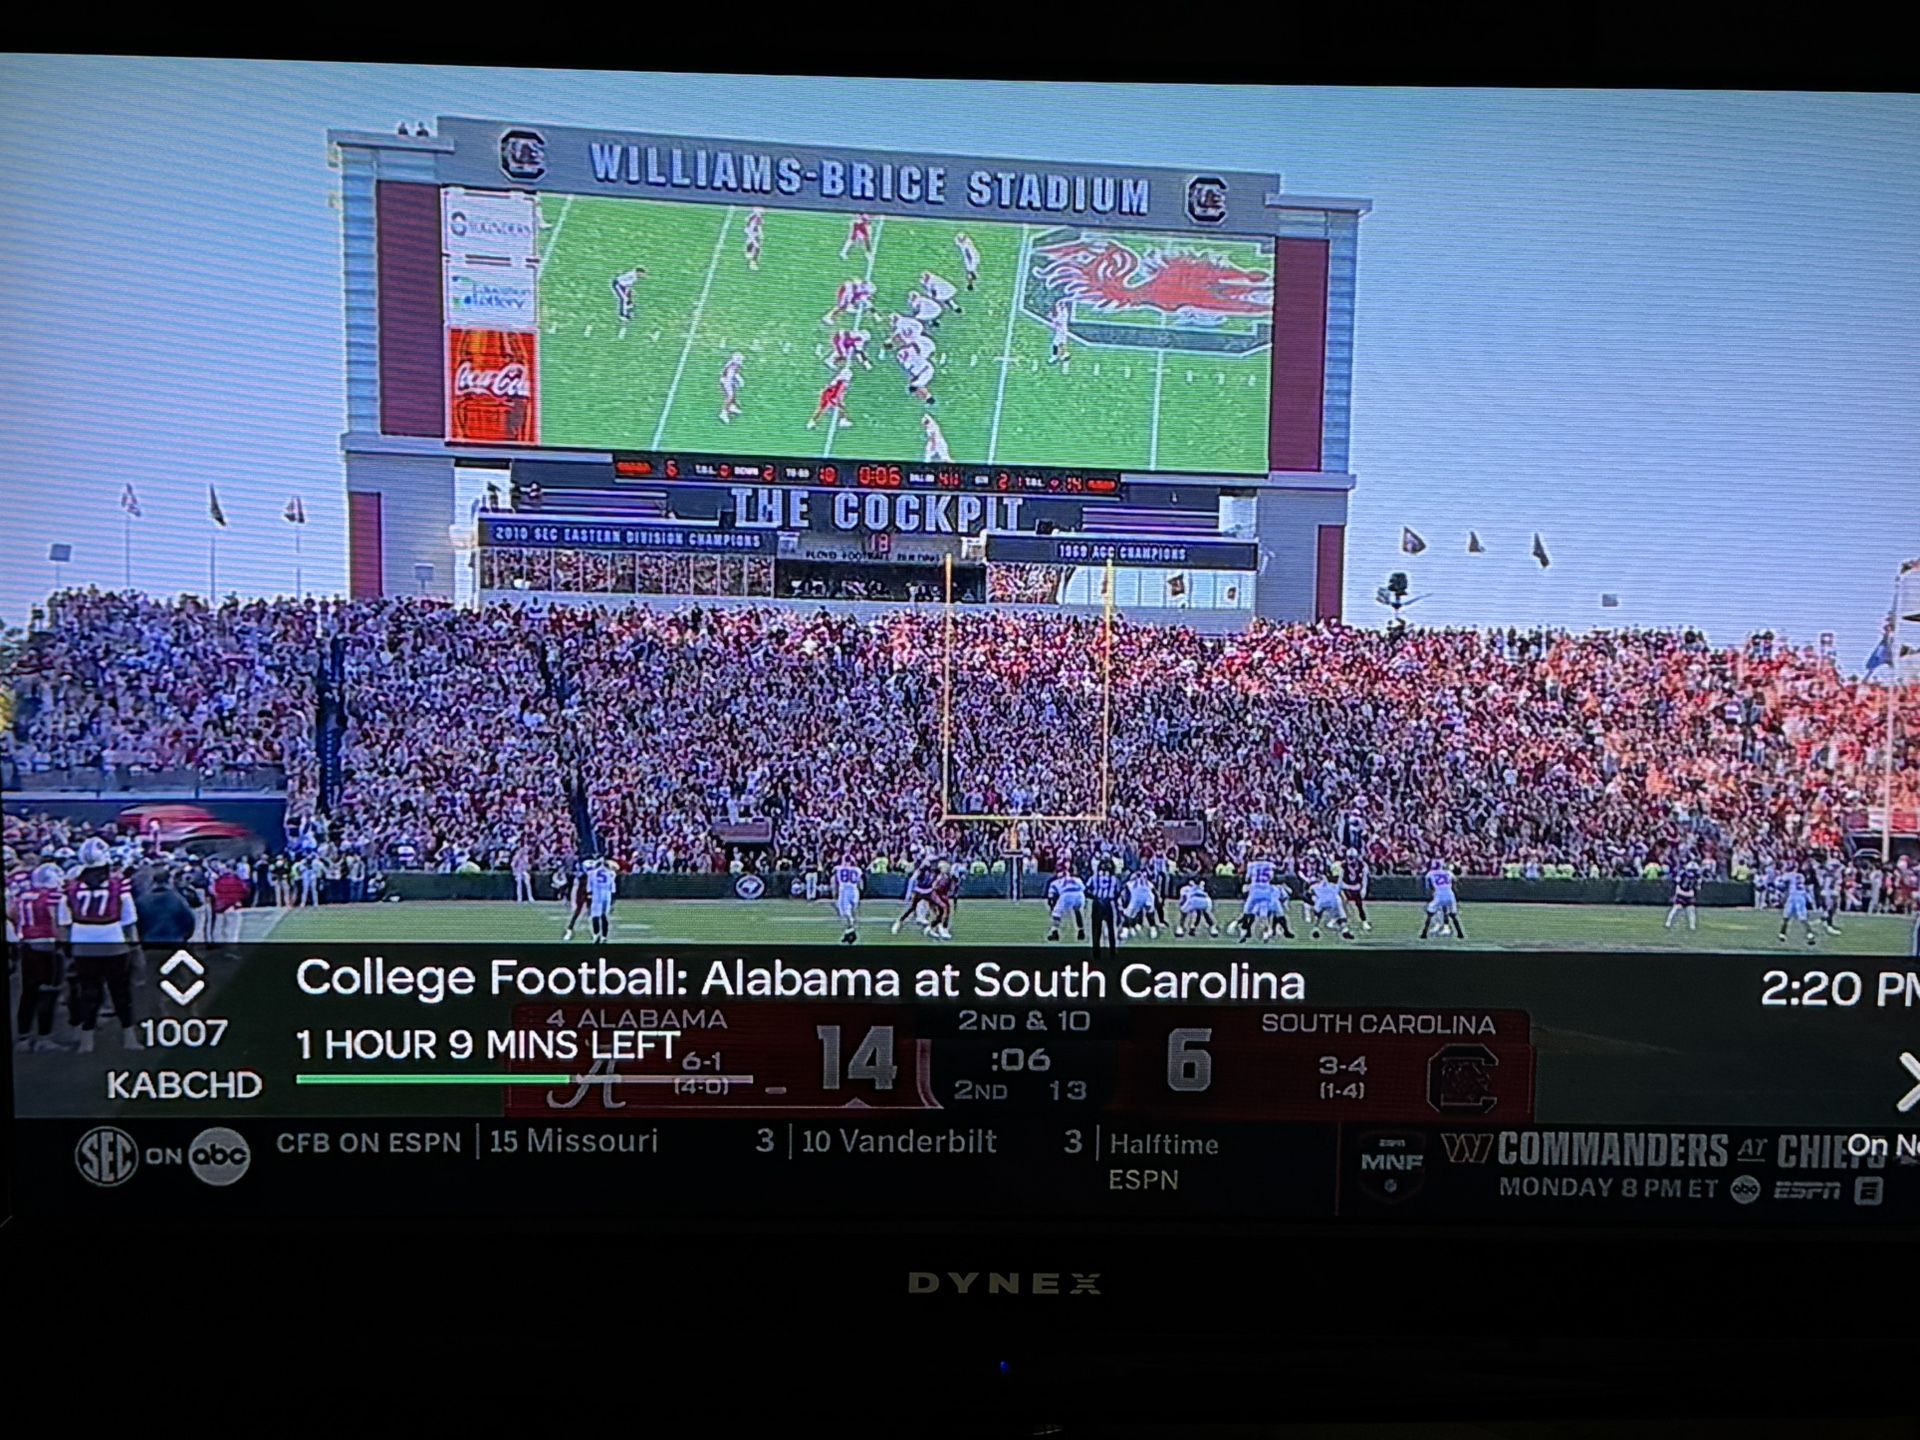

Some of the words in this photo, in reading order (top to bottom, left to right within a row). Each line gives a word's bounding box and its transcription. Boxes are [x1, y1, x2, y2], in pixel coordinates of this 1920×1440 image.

[591, 142, 946, 203] WILLIAMS-BRICE
[967, 172, 1151, 216] STADIUM
[859, 467, 900, 486] 0:06
[731, 488, 809, 529] THE
[834, 492, 1024, 533] COCKPIT
[494, 526, 528, 541] 2010
[533, 528, 558, 542] SEC
[563, 529, 621, 544] EASTERN
[626, 530, 684, 546] DIVISION
[688, 532, 761, 548] CHAMPIONS
[1091, 545, 1115, 559] ACC
[1119, 546, 1186, 561] CHAMPIONS
[76, 889, 109, 916] 77
[297, 957, 476, 1004] College
[490, 957, 688, 997] Football:
[701, 960, 901, 998] Alabama
[915, 962, 960, 998] at
[973, 961, 1106, 998] South
[1120, 962, 1306, 1001] Carolina
[1761, 970, 1863, 1007] 2:20
[545, 1008, 565, 1028] 4
[576, 1008, 728, 1029] ALABAMA
[958, 1009, 1015, 1031] 2ND
[1025, 1010, 1048, 1031] &
[1058, 1010, 1090, 1031] 10
[1261, 1013, 1352, 1034] SOUTH
[1359, 1013, 1497, 1035] CAROLINA
[140, 1018, 228, 1048] 1007
[297, 1029, 312, 1060] 1
[325, 1029, 437, 1060] HOUR
[448, 1029, 473, 1059] 9
[486, 1030, 578, 1060] MINS
[592, 1030, 682, 1060] LEFT
[682, 1051, 721, 1072] 6-1
[816, 1024, 898, 1090] 14
[991, 1047, 1051, 1073] :06
[1167, 1028, 1213, 1092] 6
[1318, 1055, 1368, 1075] 3-4
[106, 1070, 263, 1100] KABCHD
[954, 1079, 1008, 1100] 2ND
[1049, 1080, 1087, 1100] 13
[1319, 1081, 1365, 1100] (1-4)
[276, 1132, 331, 1155] CFB
[339, 1132, 380, 1154] ON
[389, 1132, 462, 1154] ESPN
[490, 1129, 518, 1153] 15
[527, 1128, 659, 1154] Missouri
[755, 1127, 775, 1153] 3
[802, 1129, 831, 1153] 10
[839, 1128, 998, 1154] Vanderbilt
[1063, 1128, 1083, 1154] 3
[1110, 1133, 1220, 1156] Halftime
[1498, 1130, 1728, 1168] COMMANDERS
[1736, 1137, 1769, 1157] AT
[1847, 1132, 1889, 1157] On
[1896, 1133, 1920, 1157] N
[79, 1131, 134, 1183] SEC
[145, 1147, 183, 1165] ON
[192, 1145, 248, 1166] abc
[1361, 1153, 1424, 1171] MNF
[1109, 1169, 1179, 1191] ESPN
[1500, 1176, 1614, 1199] MONDAY
[1621, 1177, 1639, 1198] 8
[1643, 1177, 1683, 1199] PM
[1688, 1178, 1719, 1199] ET
[1773, 1181, 1841, 1200] ESPN
[907, 1271, 1102, 1295] DYNEX
